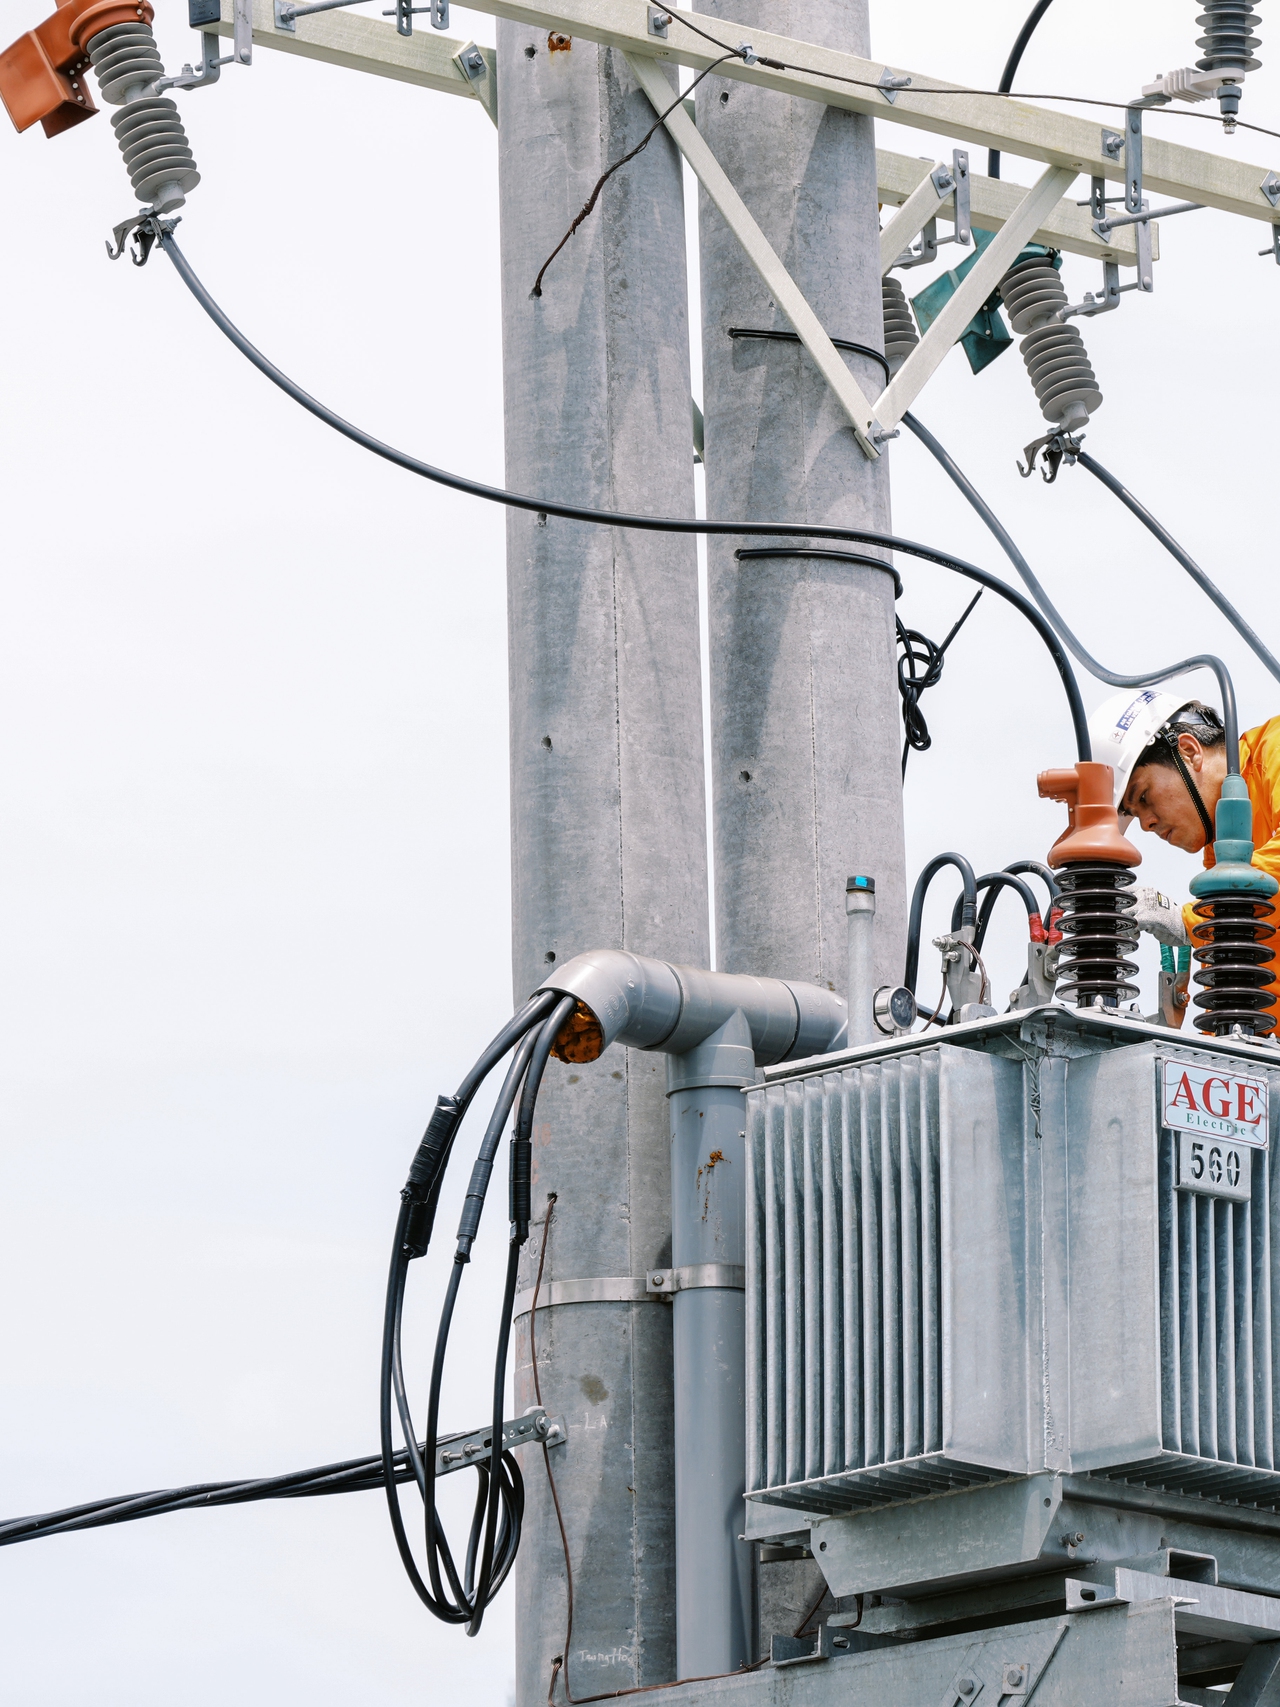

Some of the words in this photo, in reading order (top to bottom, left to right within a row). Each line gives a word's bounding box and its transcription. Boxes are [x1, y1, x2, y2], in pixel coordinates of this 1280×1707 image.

[1171, 1071, 1262, 1125] AGE
[1186, 1113, 1246, 1135] Electric
[1191, 1142, 1240, 1187] 560
